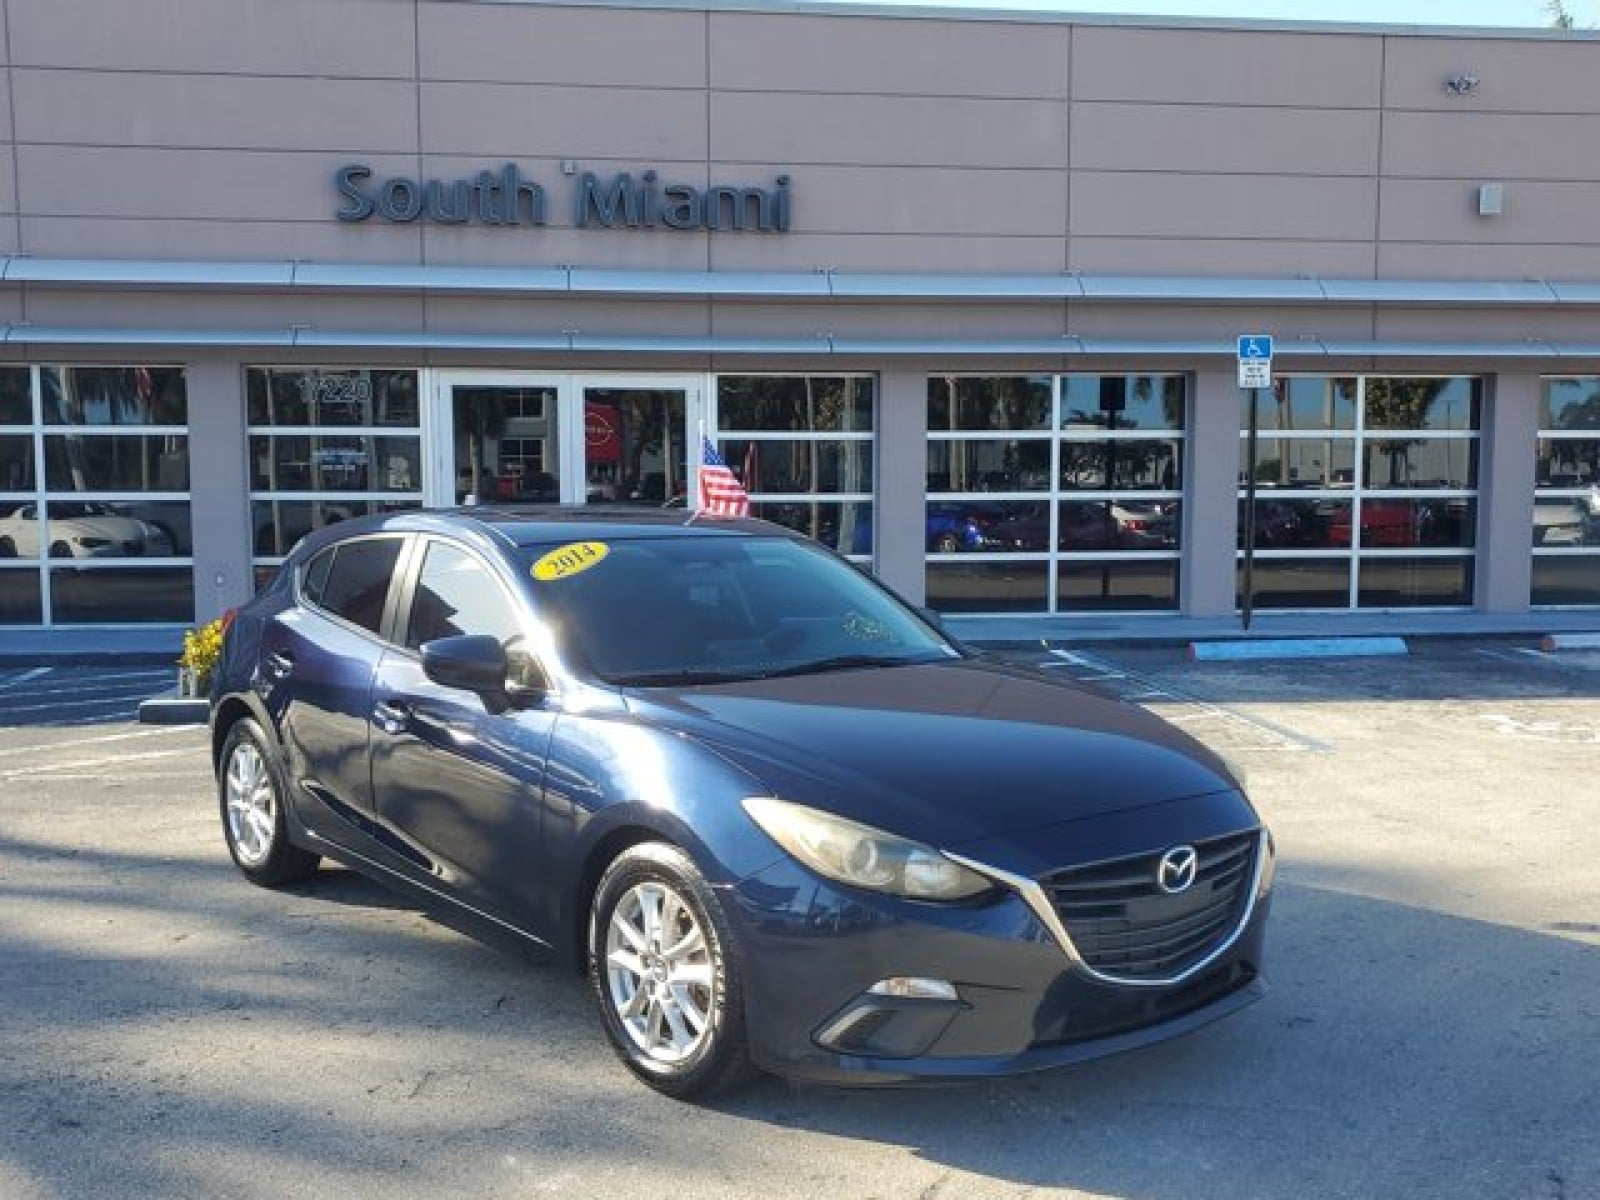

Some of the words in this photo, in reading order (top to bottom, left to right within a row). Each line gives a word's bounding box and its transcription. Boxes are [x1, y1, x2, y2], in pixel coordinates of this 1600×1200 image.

[335, 162, 546, 226] South
[575, 171, 792, 232] Miami
[545, 544, 598, 576] 2014
